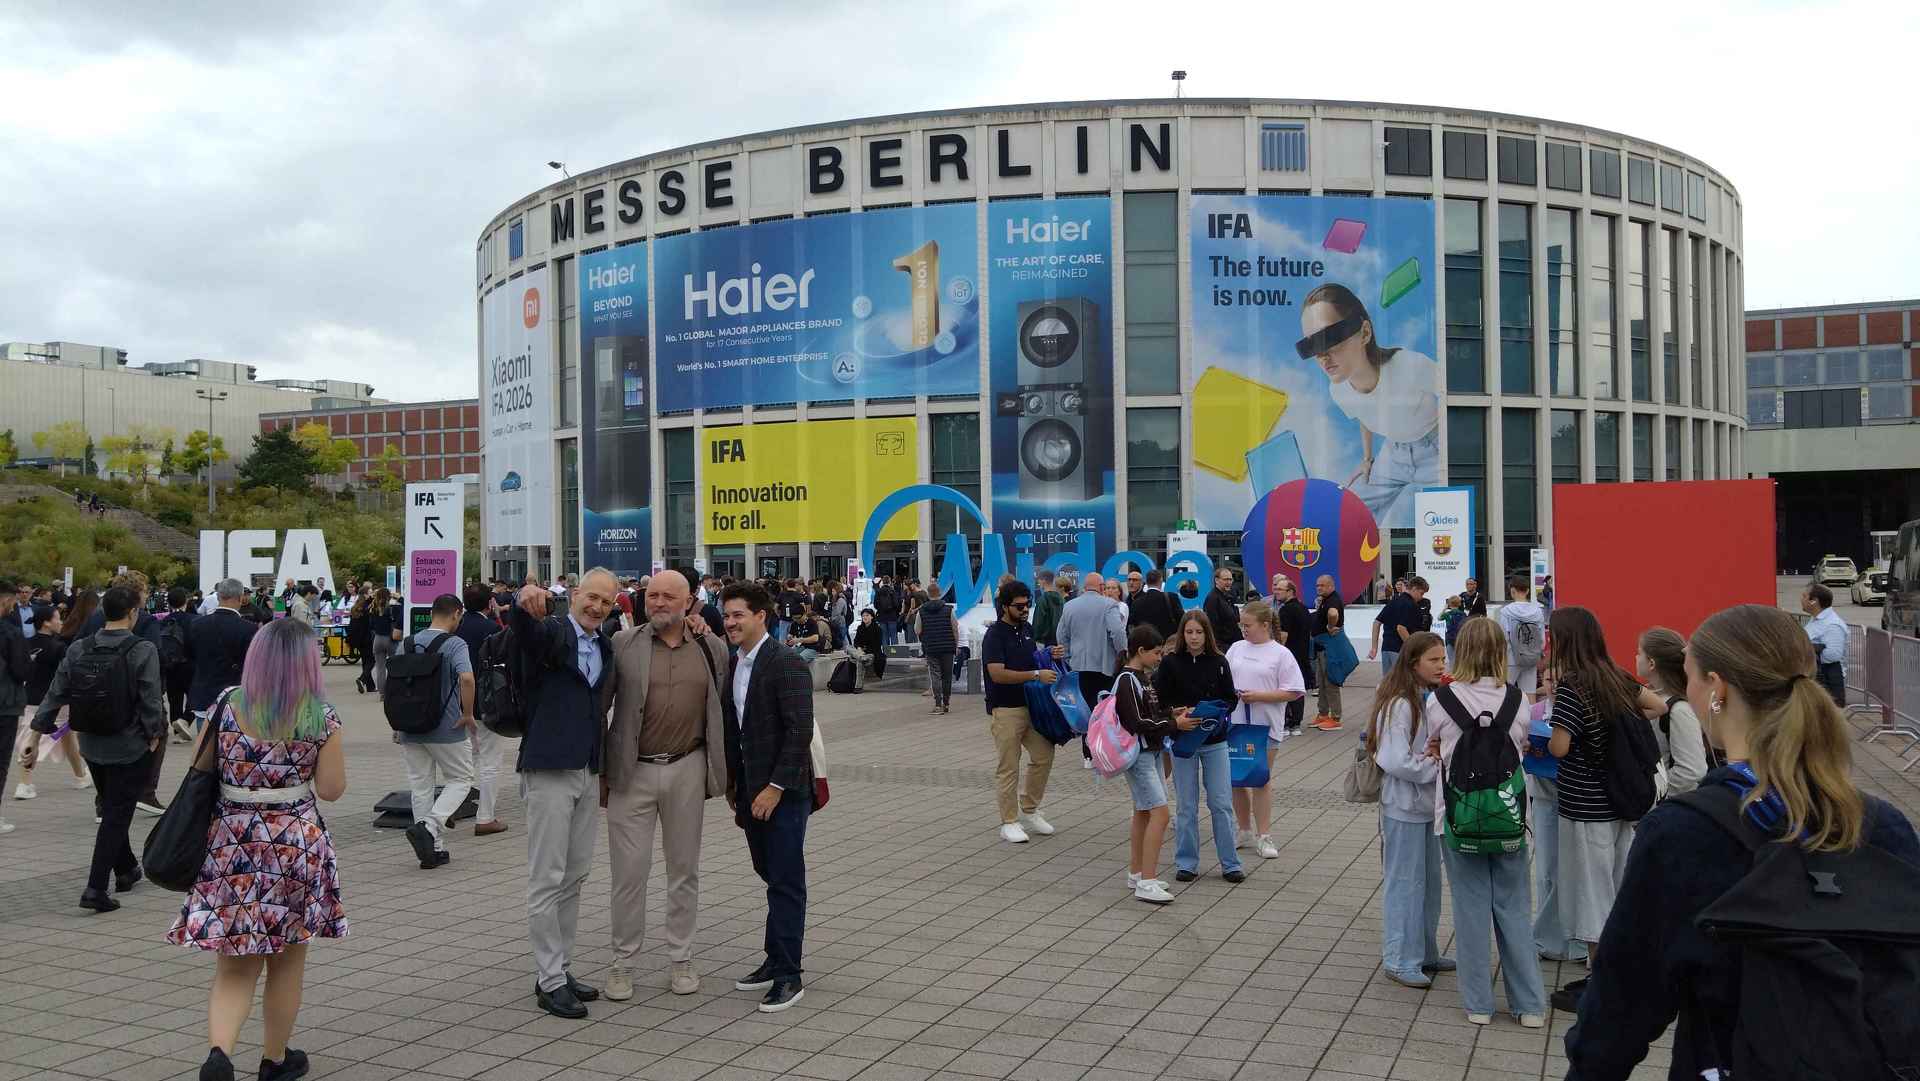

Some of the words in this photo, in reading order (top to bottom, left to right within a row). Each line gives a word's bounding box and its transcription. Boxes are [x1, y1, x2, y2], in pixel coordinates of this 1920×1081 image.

[551, 161, 734, 244] MESSE
[809, 123, 1170, 194] BERLIN
[1007, 215, 1091, 243] Haier
[1208, 213, 1252, 239] IFA
[995, 257, 1019, 267] THE
[1022, 256, 1045, 266] ART
[1049, 255, 1066, 265] OF
[1209, 256, 1251, 277] The
[1257, 256, 1324, 277] future
[589, 262, 636, 290] Haier
[1012, 268, 1087, 280] REIMAGINED
[684, 262, 815, 320] Haier
[1213, 285, 1233, 306] is
[1238, 288, 1292, 306] now.
[594, 295, 632, 312] BEYOND
[665, 333, 677, 342] No.
[683, 329, 715, 340] GLOBAL
[718, 326, 748, 336] MAJOR
[750, 320, 806, 334] APPLIANCES
[808, 318, 842, 329] BRAND
[706, 340, 714, 348] for
[726, 336, 769, 347] Consecutive
[771, 334, 792, 342] Years
[492, 344, 531, 386] Xiaomi
[677, 362, 703, 372] World's
[704, 361, 716, 369] No.
[722, 358, 749, 367] SMART
[751, 357, 775, 365] HOME
[777, 352, 828, 363] ENTERPRISE
[506, 383, 533, 412] 2026
[711, 438, 746, 464] IFA
[415, 492, 435, 506] IFA
[712, 481, 808, 504] Innovation
[712, 511, 736, 531] for
[740, 509, 766, 530] all.
[1012, 519, 1054, 530] MULTI
[1058, 518, 1096, 529] CARE
[600, 528, 637, 540] HORIZON
[1033, 533, 1080, 544] LLECTIO
[199, 529, 336, 598] IFA
[416, 566, 447, 577] Eingang
[416, 577, 437, 587] hub27
[938, 532, 1214, 621] Midea
